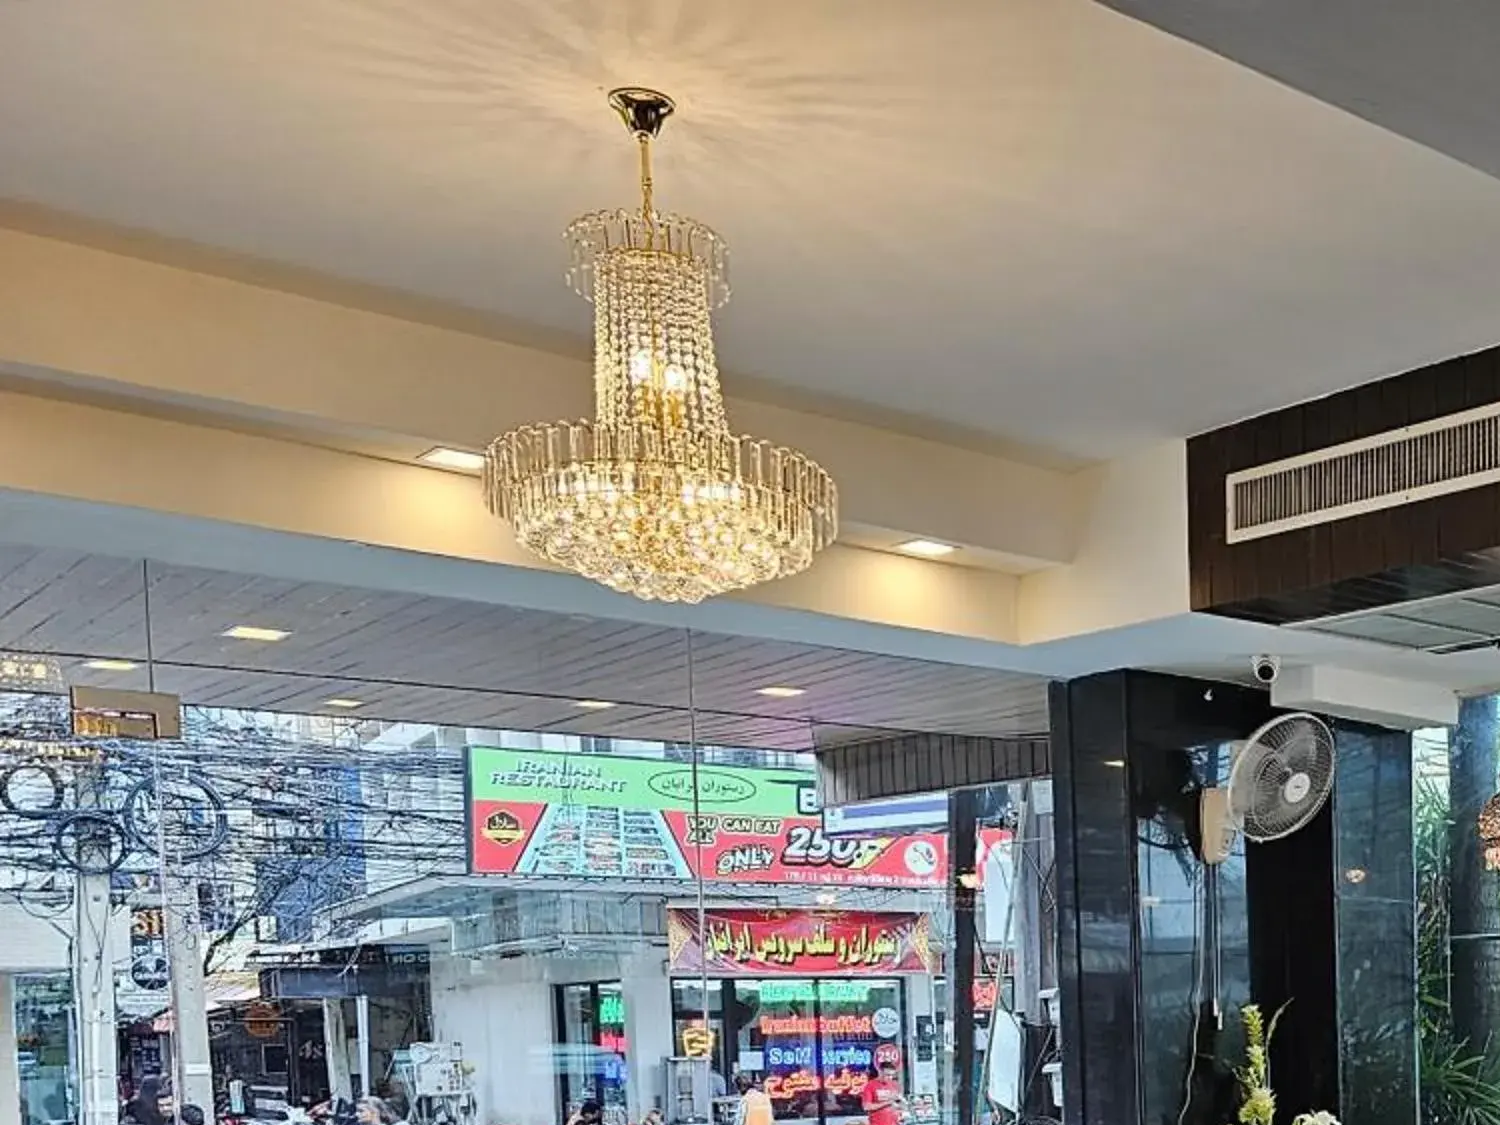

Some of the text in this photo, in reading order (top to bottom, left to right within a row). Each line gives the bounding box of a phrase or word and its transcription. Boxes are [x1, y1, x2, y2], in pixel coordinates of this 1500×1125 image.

[515, 757, 602, 778] IRANIAN
[491, 771, 628, 793] RESTAURANT
[721, 816, 754, 833] CAN
[754, 819, 781, 834] EAT
[716, 846, 775, 874] ONLY
